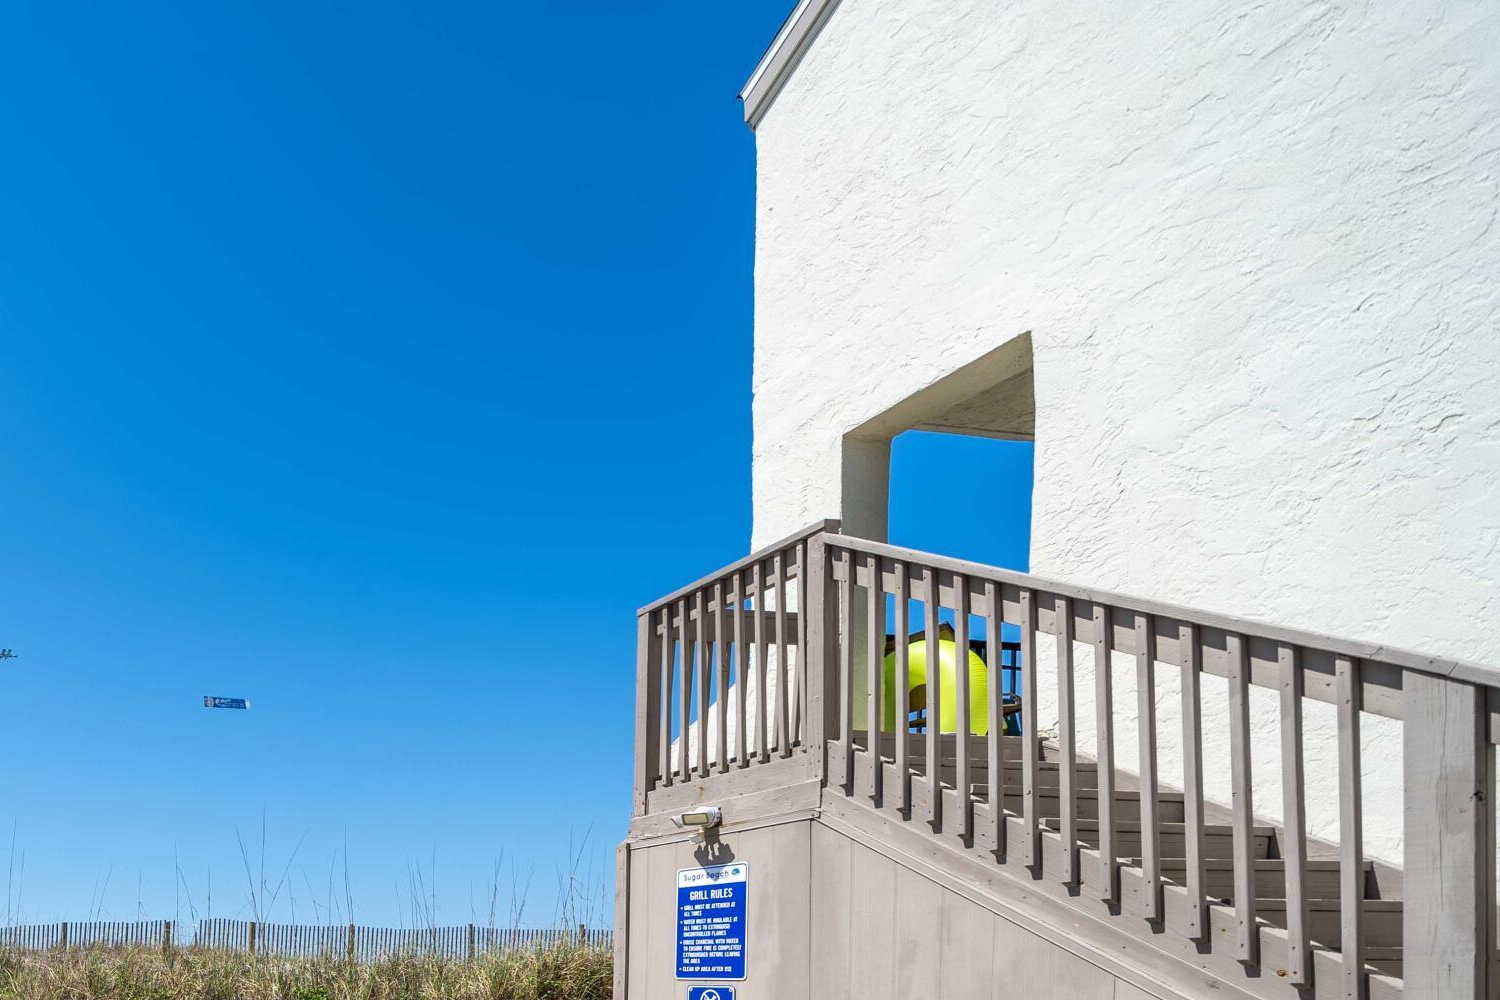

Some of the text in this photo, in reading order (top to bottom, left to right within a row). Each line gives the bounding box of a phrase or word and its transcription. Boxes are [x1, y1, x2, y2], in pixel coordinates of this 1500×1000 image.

[684, 870, 729, 882] Sugar Beach
[690, 888, 732, 900] GRILL RULES
